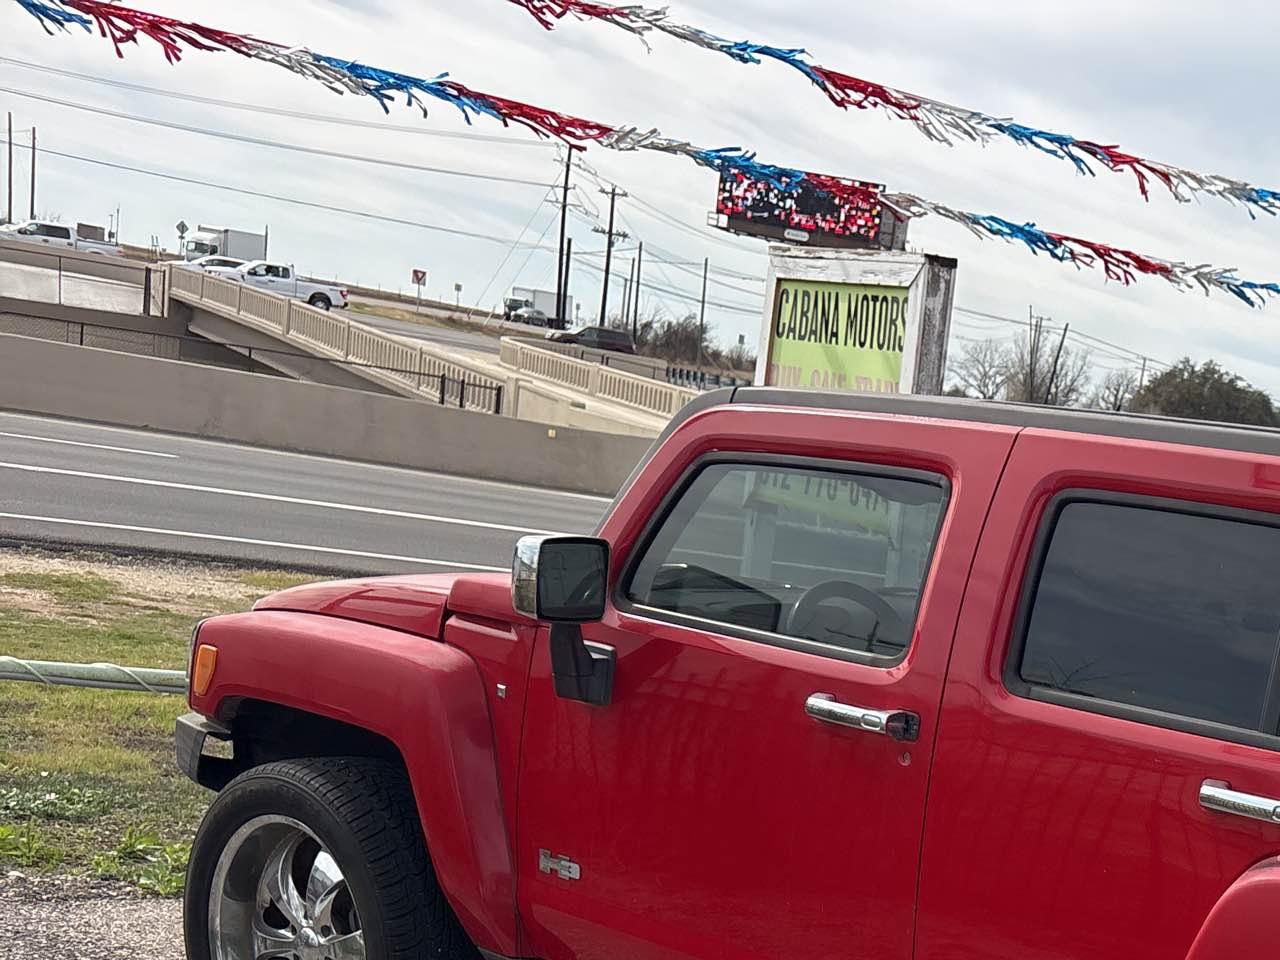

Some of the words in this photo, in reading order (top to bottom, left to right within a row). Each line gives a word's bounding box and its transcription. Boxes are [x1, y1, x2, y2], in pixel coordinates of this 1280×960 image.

[775, 287, 839, 346] CABANA
[843, 292, 908, 353] MOTORS
[539, 848, 581, 880] H3
